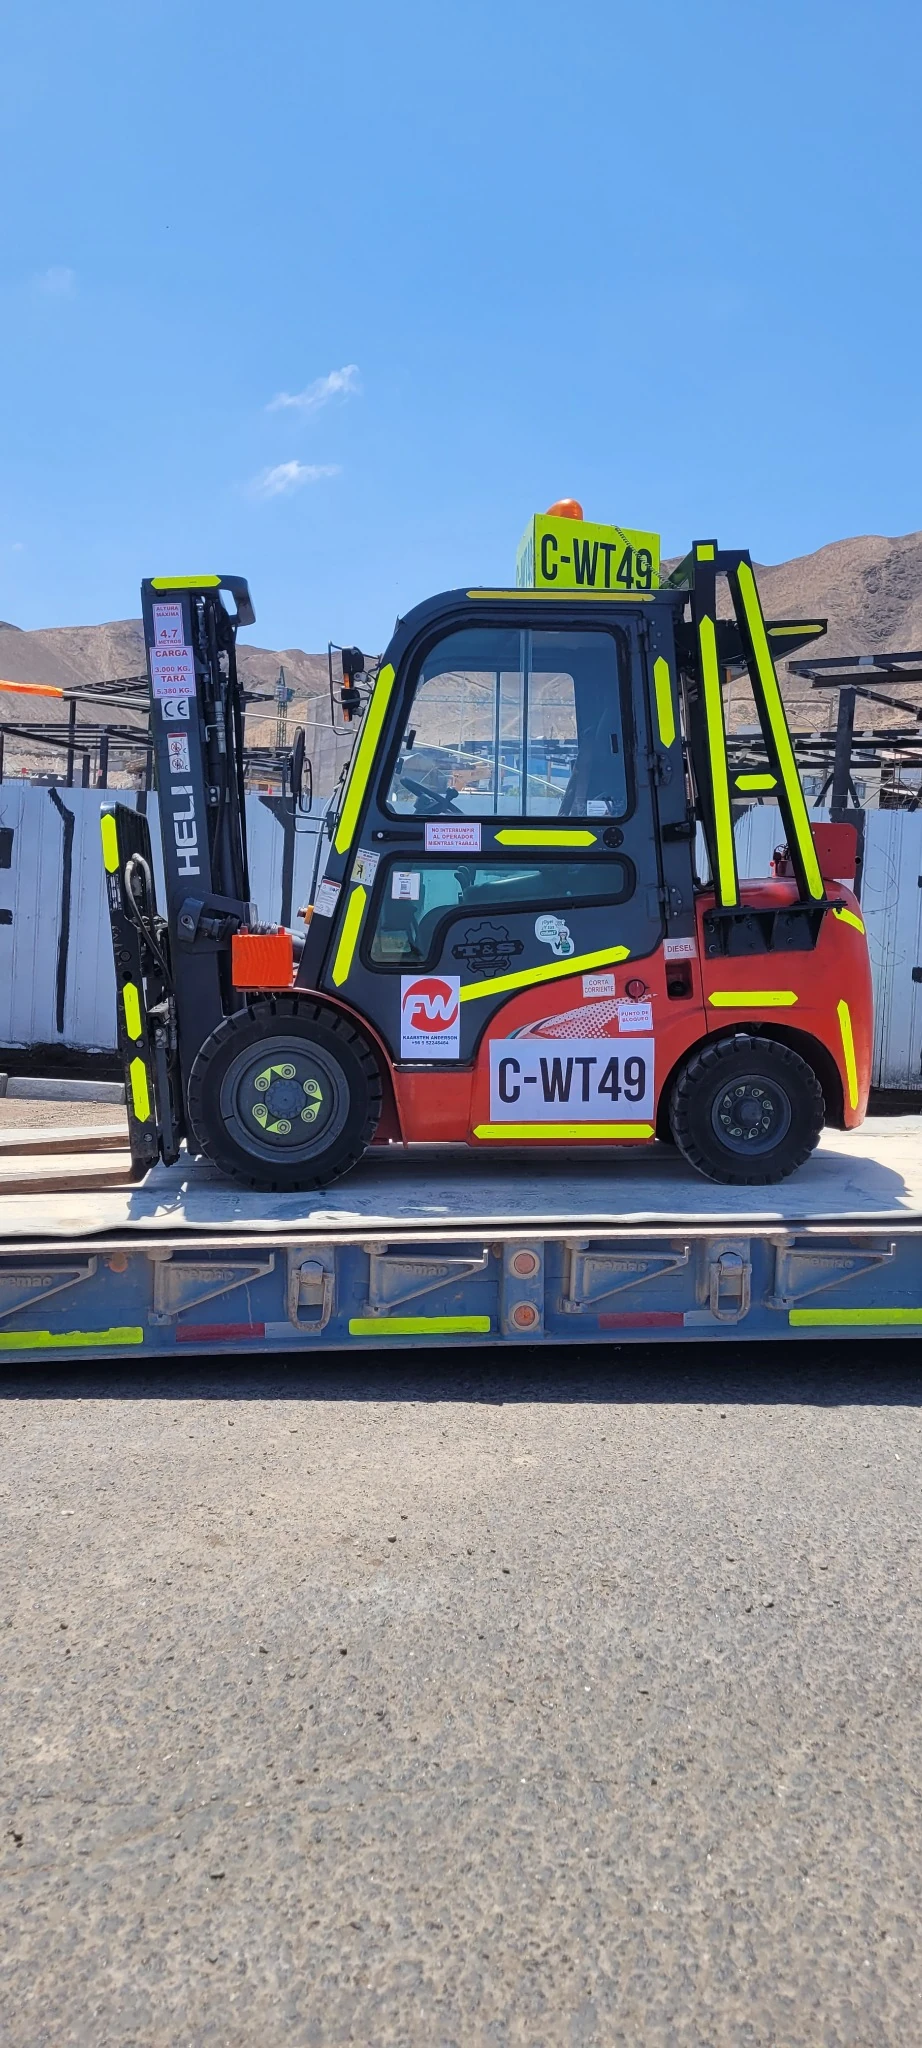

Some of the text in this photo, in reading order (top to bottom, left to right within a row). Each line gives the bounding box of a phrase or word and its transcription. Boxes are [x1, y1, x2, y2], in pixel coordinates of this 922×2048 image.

[541, 533, 653, 589] C-WT49
[160, 629, 178, 638] 4.7
[164, 700, 187, 717] CE
[171, 785, 200, 876] HELI
[457, 942, 516, 956] T&S
[667, 944, 693, 954] DIESEL
[584, 985, 614, 994] CORRIENTE
[402, 989, 459, 1025] FW
[498, 1055, 646, 1104] C-WT49
